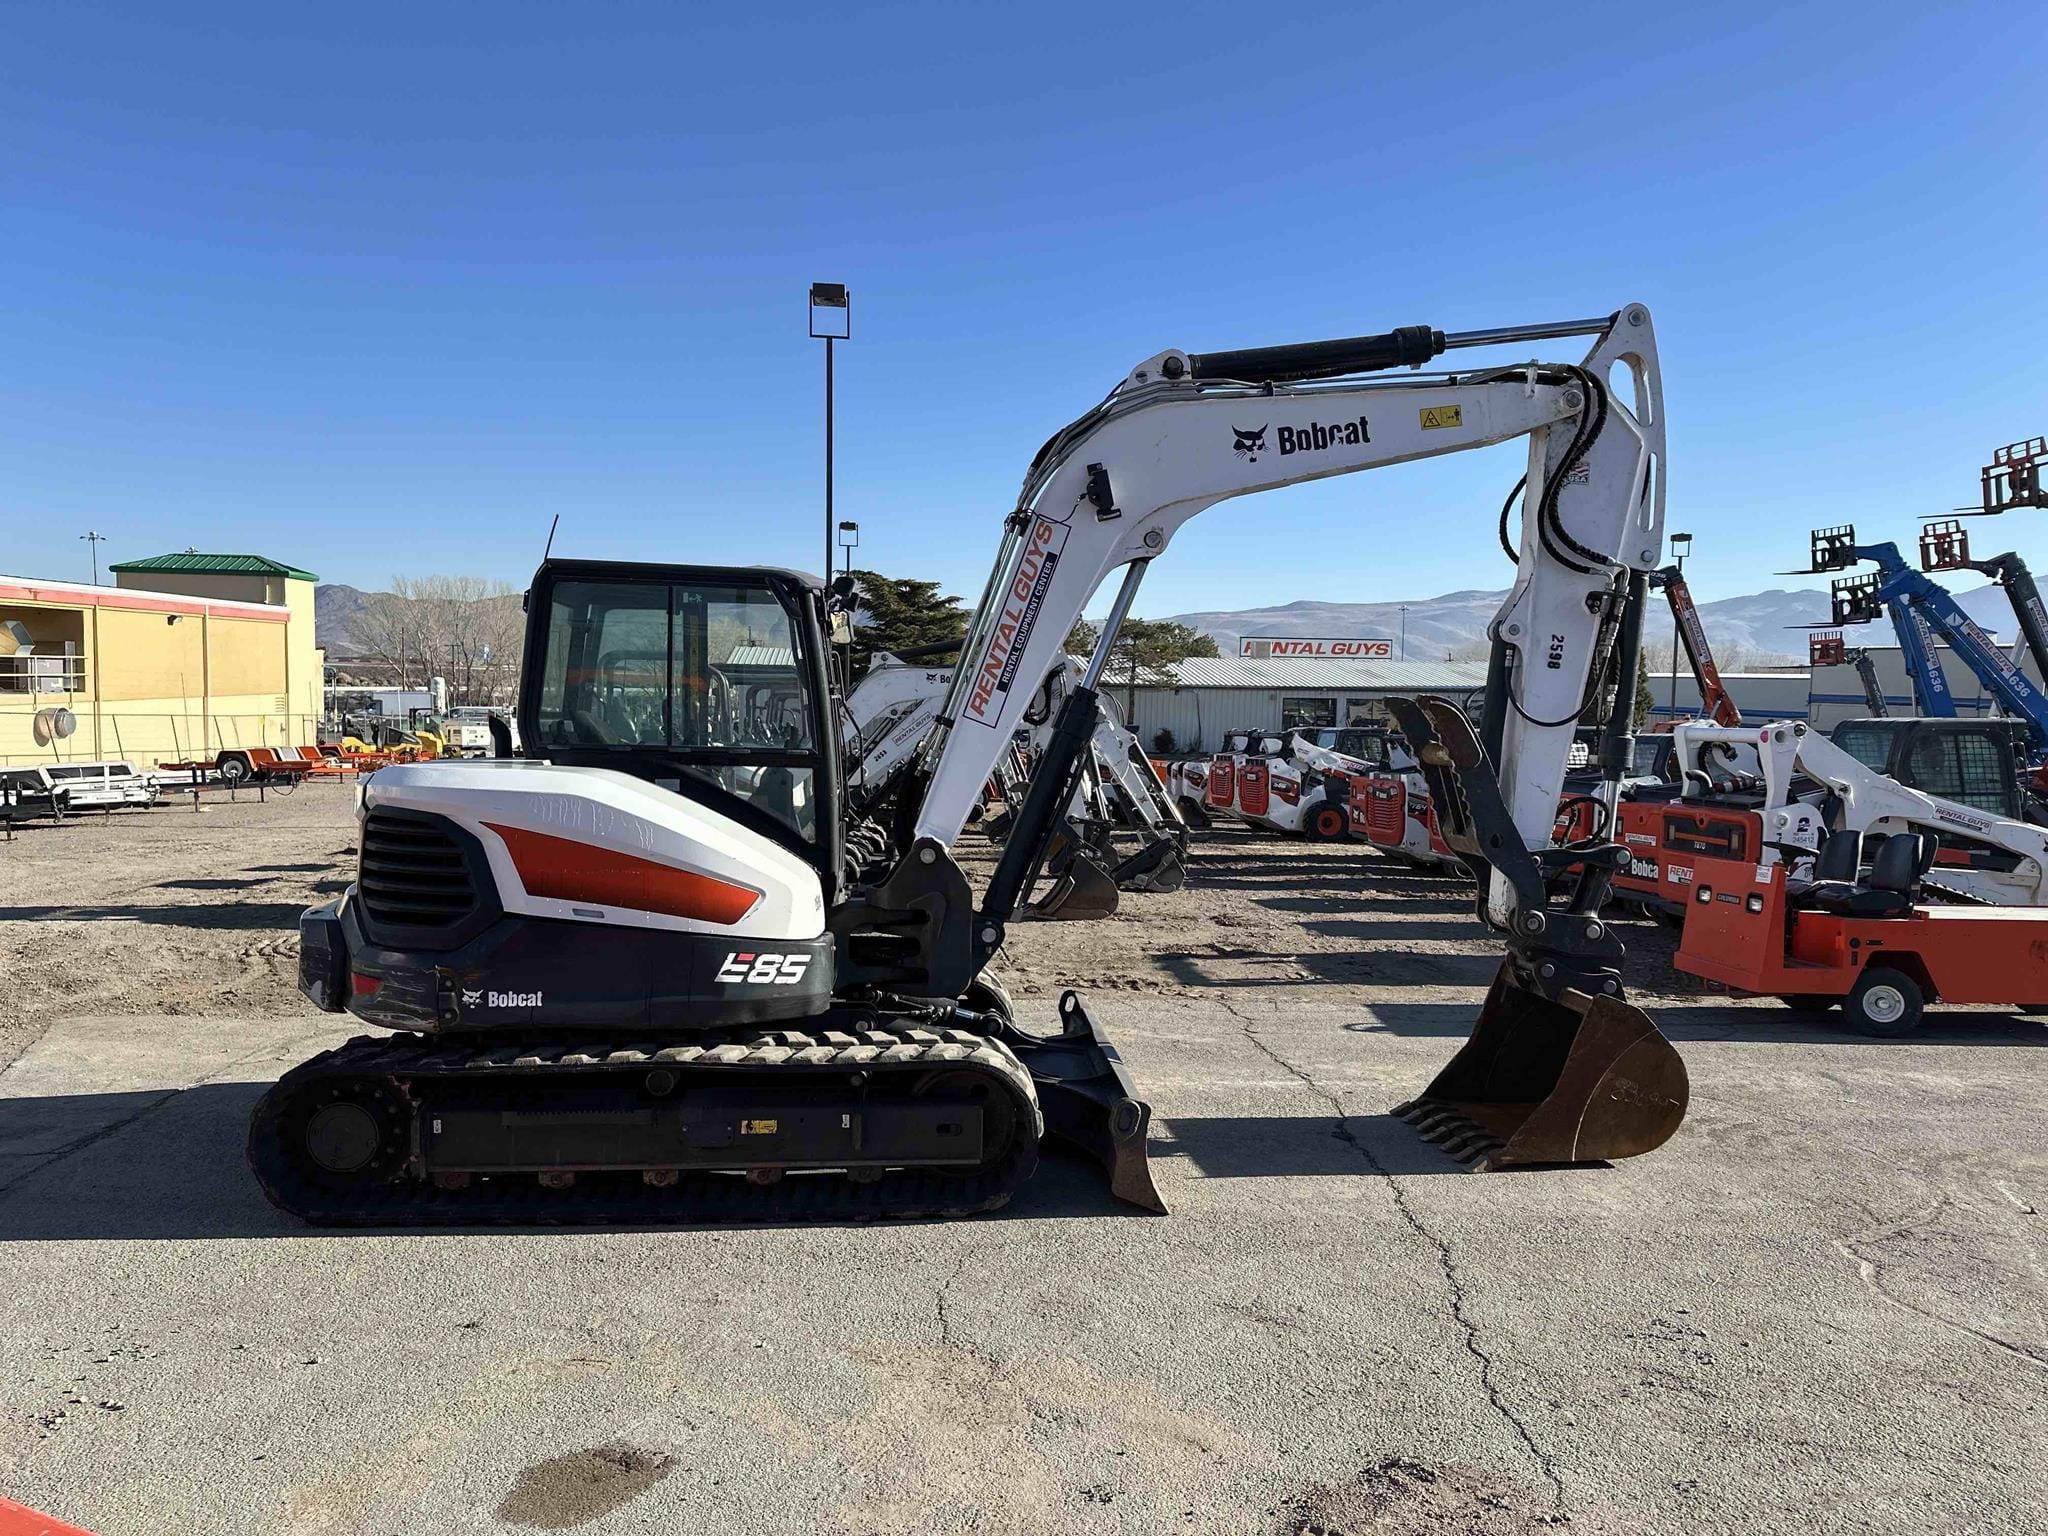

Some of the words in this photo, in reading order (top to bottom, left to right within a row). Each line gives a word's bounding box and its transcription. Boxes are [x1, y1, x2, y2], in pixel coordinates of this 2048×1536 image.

[1277, 416, 1370, 456] Bobcat
[969, 606, 1023, 717] RENTAL
[1014, 521, 1053, 602] GUYS
[1002, 649, 1017, 684] RENTAL
[1016, 600, 1039, 649] EQUIPMENT
[1035, 561, 1054, 597] CENTER
[1243, 641, 1326, 655] RNTAL
[1331, 643, 1390, 656] GUYS
[1547, 634, 1565, 670] 2598
[1965, 622, 1997, 656] RENTAL
[1993, 653, 2015, 674] GUYS
[1929, 670, 1944, 693] 636
[2009, 675, 2031, 697] 636
[1936, 808, 1967, 822] RENTAL
[1967, 818, 1990, 829] GUYS
[1631, 860, 1659, 878] Bobca
[714, 952, 811, 984] E85
[488, 991, 543, 1008] Bobcat
